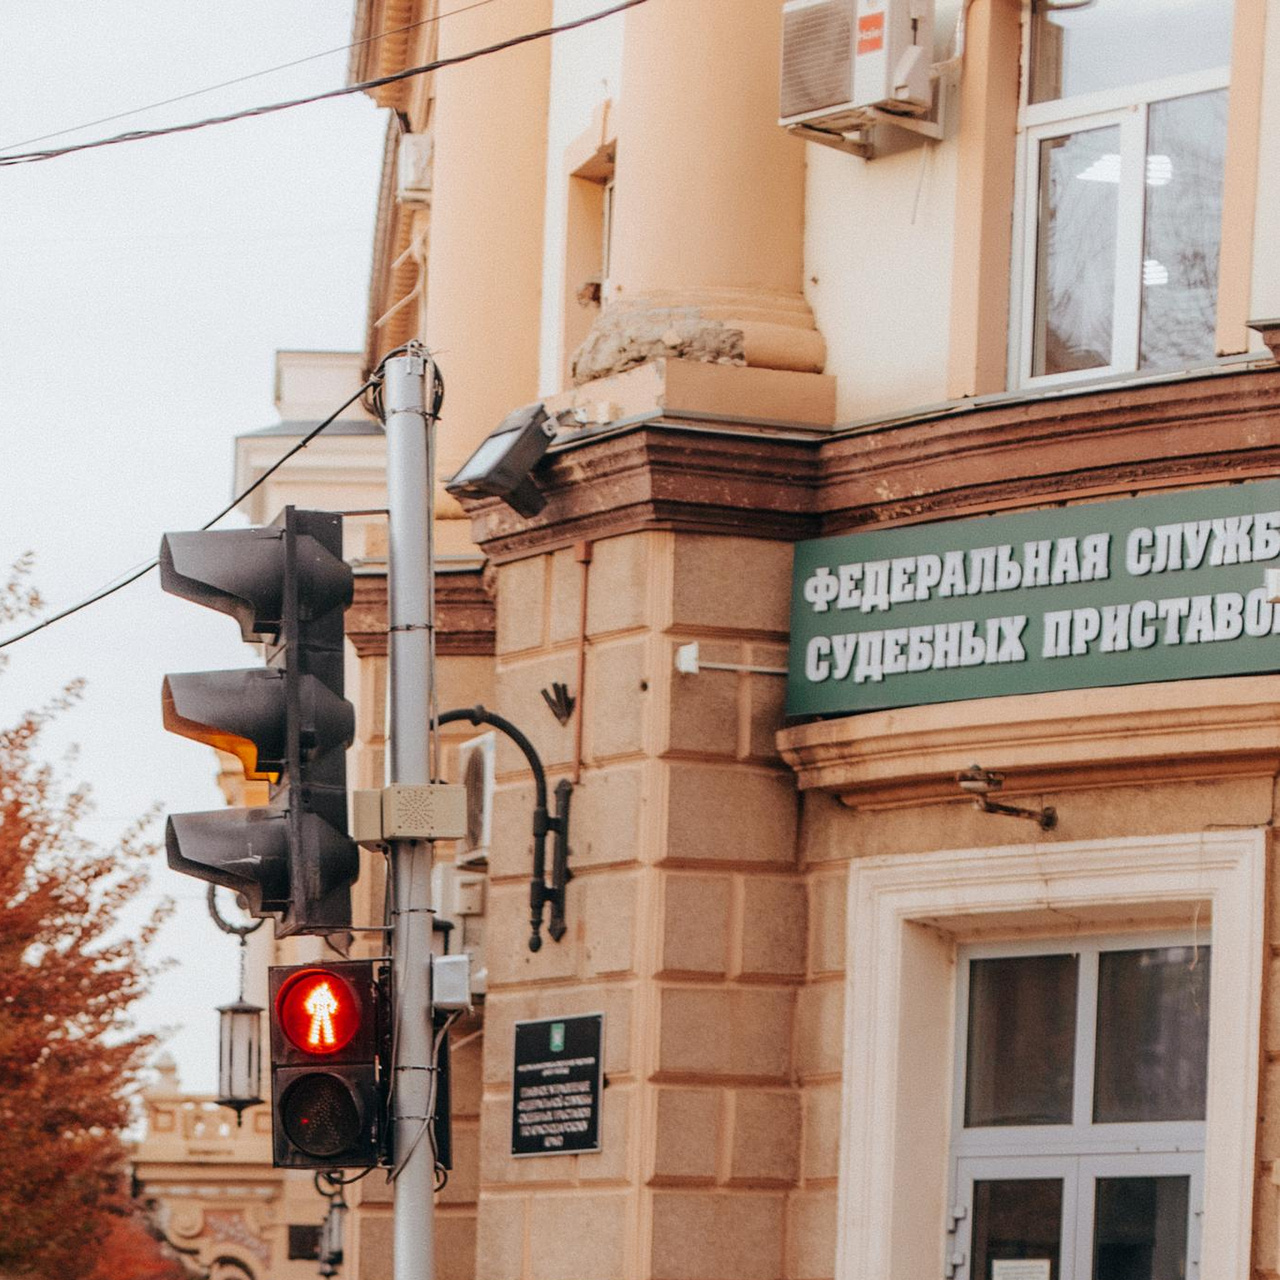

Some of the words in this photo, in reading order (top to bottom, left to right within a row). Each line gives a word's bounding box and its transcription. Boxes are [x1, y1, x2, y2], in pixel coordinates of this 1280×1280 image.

[804, 532, 1111, 613] ФЕДЕРАЛЬНАЯ
[1126, 511, 1280, 576] СЛУЖБ
[805, 615, 1028, 684] СУДЕБНЫХ
[1042, 587, 1280, 658] ПРИСТАВО
